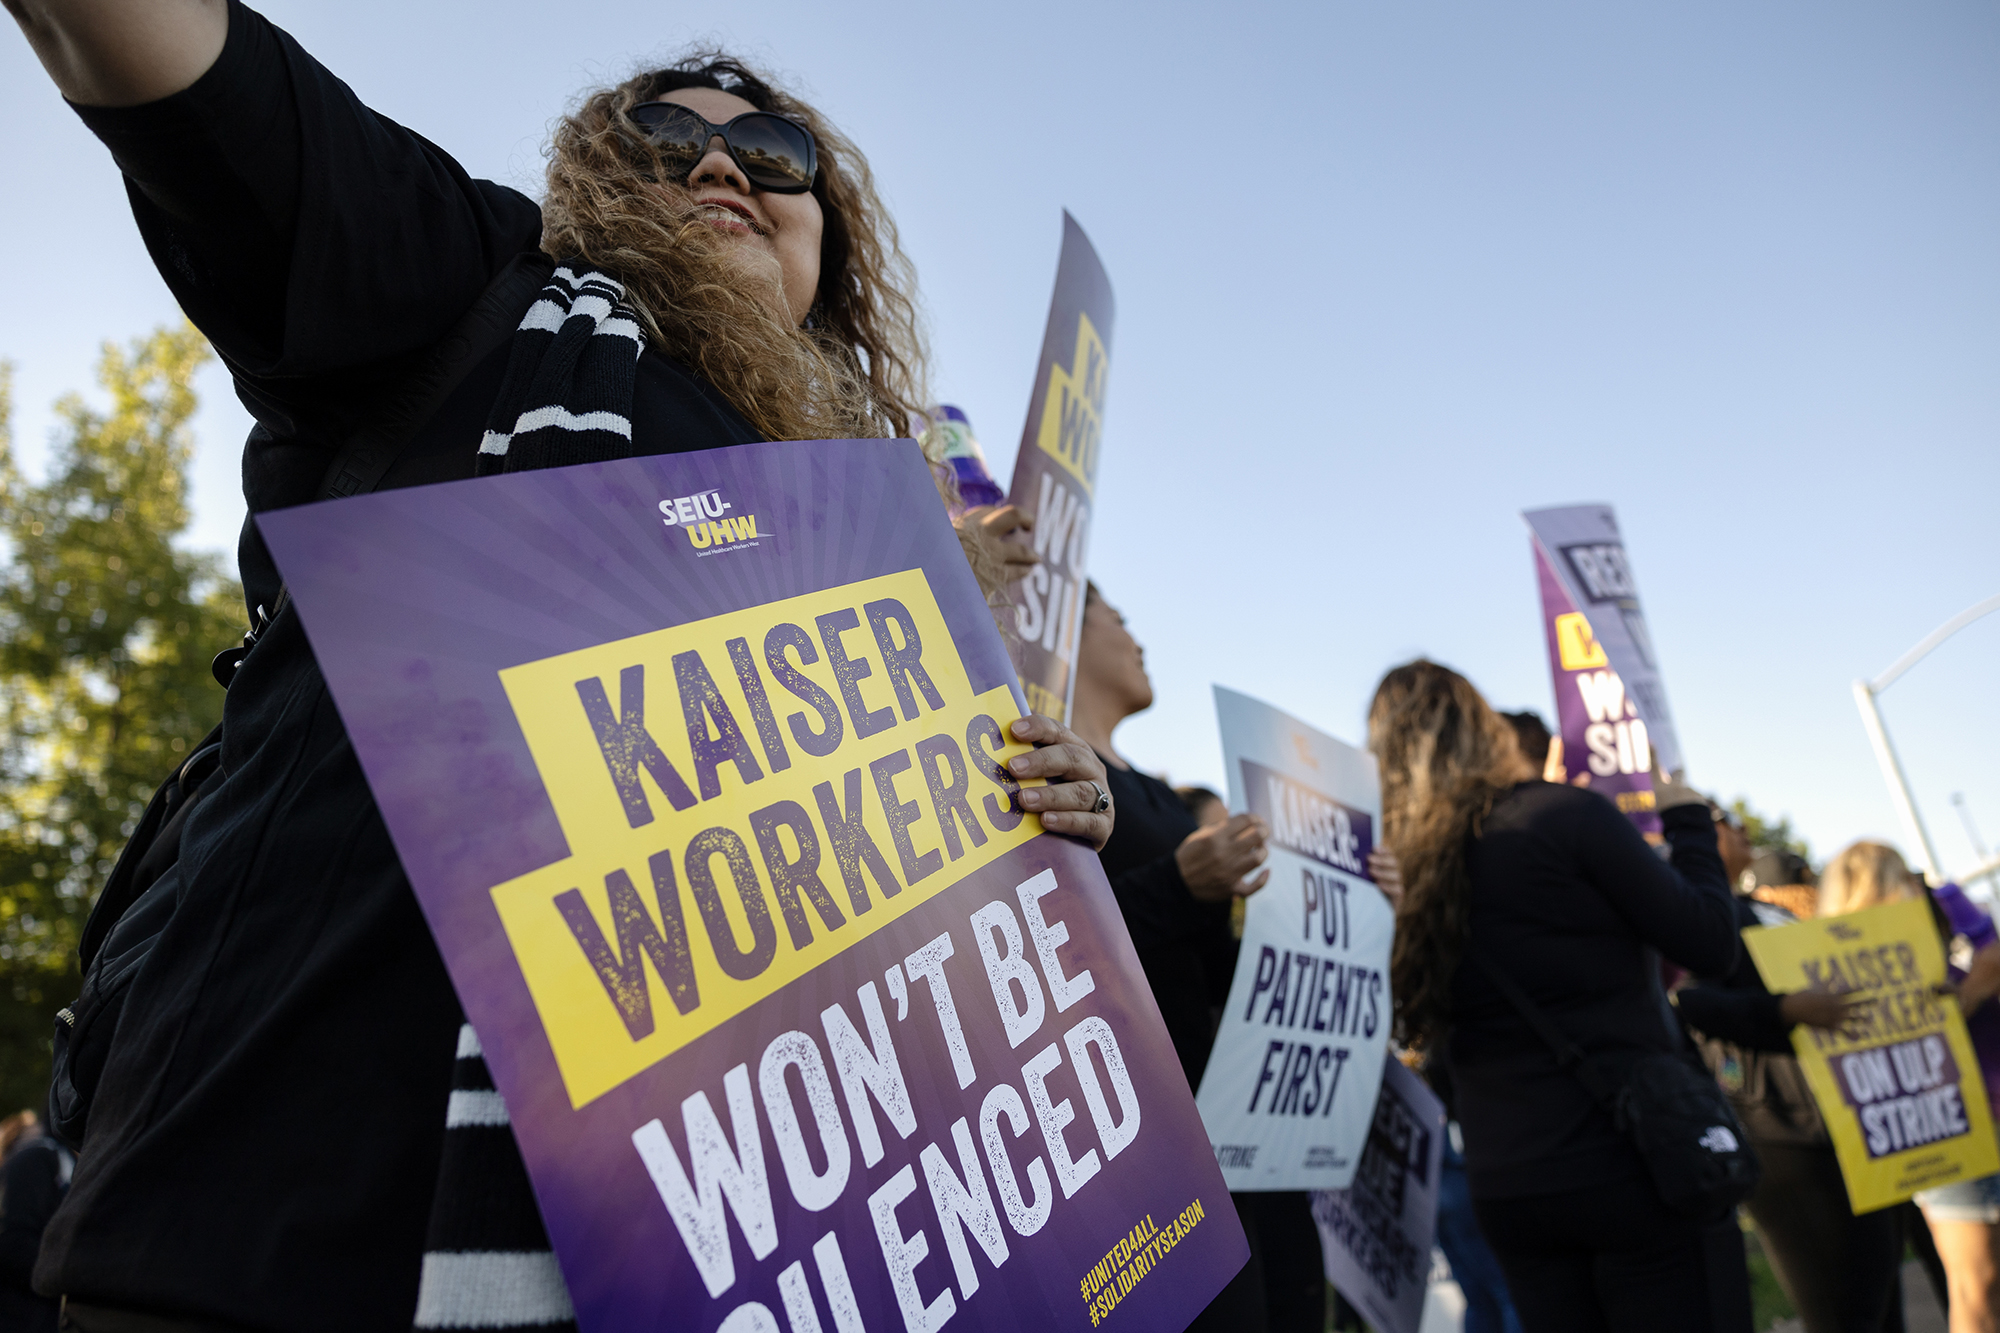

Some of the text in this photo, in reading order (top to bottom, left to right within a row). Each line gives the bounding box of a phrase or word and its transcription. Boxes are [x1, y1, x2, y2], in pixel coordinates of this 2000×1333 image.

[658, 492, 731, 526] SEIU-
[686, 514, 758, 549] UHW
[574, 598, 946, 829] KAISER
[1267, 775, 1363, 875] KAISER:
[552, 713, 1026, 1043] WORKERS
[1302, 869, 1349, 951] PUT
[1244, 944, 1383, 1040] PATIENTS
[631, 867, 1096, 1299] WON'T BE
[1248, 1039, 1351, 1118] FIRST
[1841, 1035, 1946, 1104] ON ULP
[1861, 1083, 1968, 1156] STRIKE
[716, 1016, 1141, 1333] ENCED
[1080, 1214, 1159, 1303] #UNITED4ALL
[1089, 1198, 1205, 1328] #SOLIDARITYSEASON
